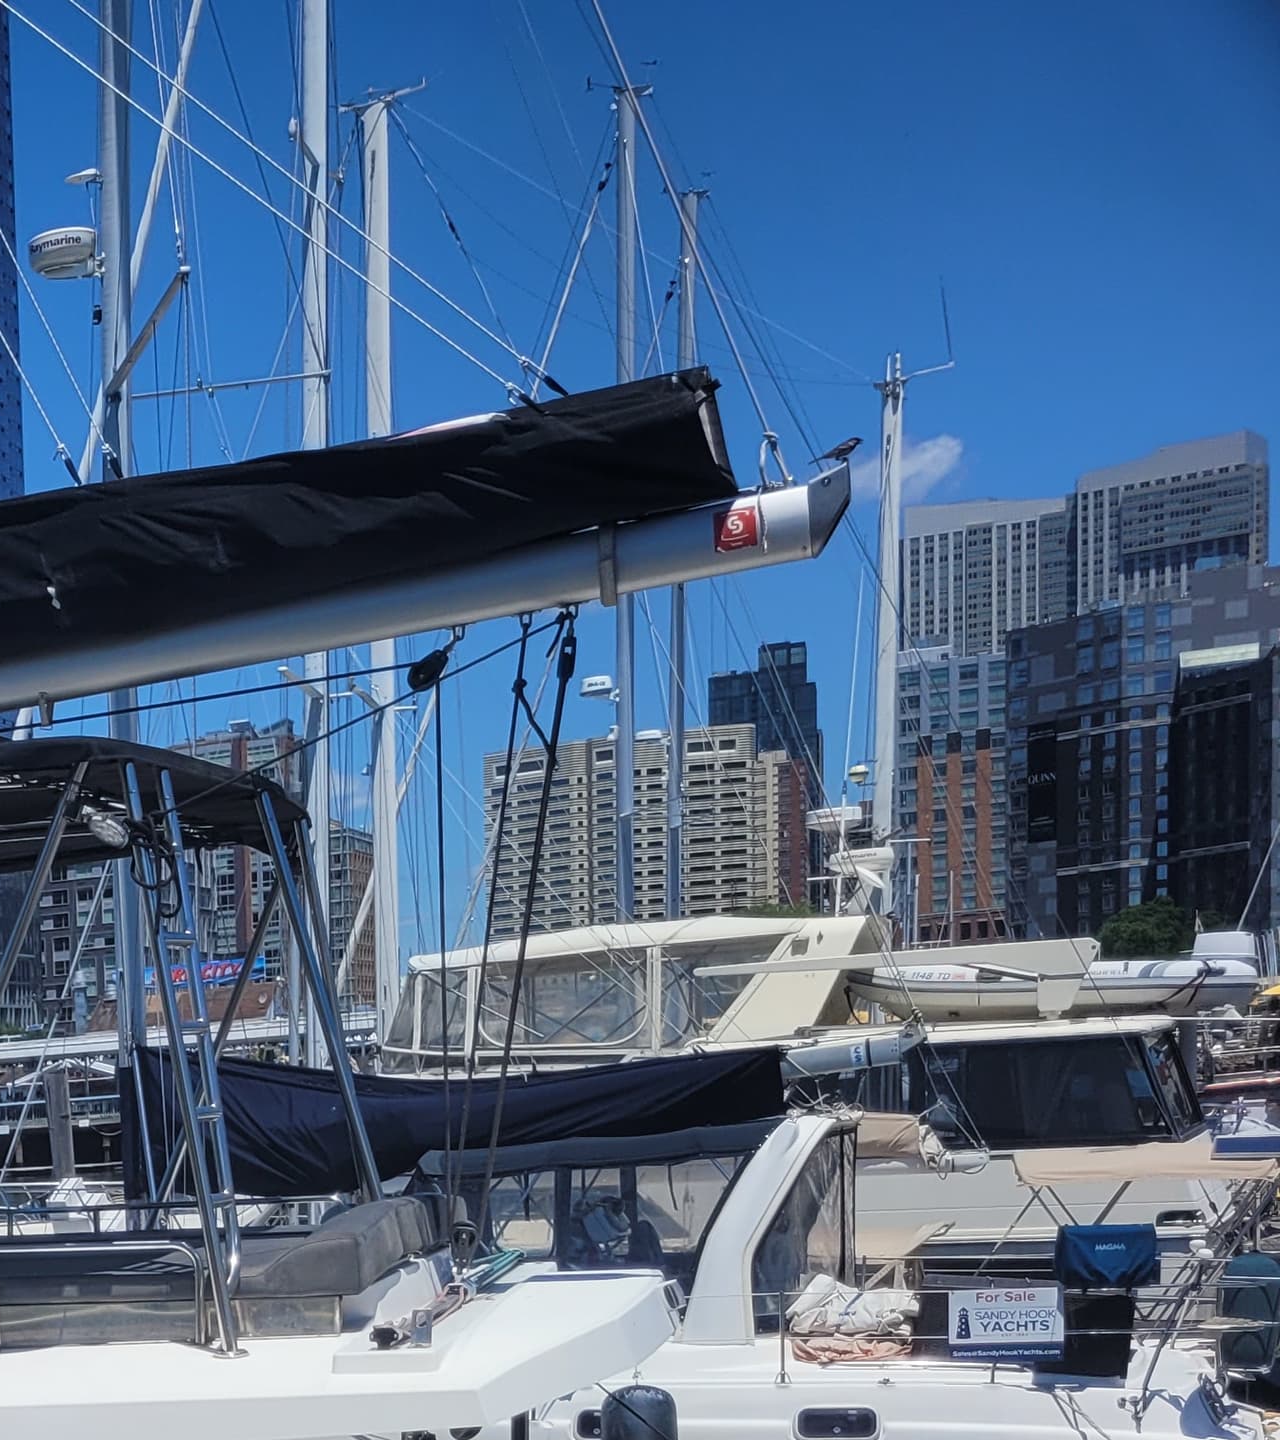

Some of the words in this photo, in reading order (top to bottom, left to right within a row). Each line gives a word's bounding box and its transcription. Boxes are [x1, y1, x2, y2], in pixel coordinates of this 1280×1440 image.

[1027, 771, 1056, 785] QUINN
[1094, 1242, 1126, 1251] MAGMA
[975, 1291, 1000, 1304] For
[1004, 1290, 1037, 1302] Sale
[974, 1310, 1017, 1321] SANDY
[1018, 1309, 1056, 1319] HOOK
[979, 1319, 1050, 1333] YACHTS
